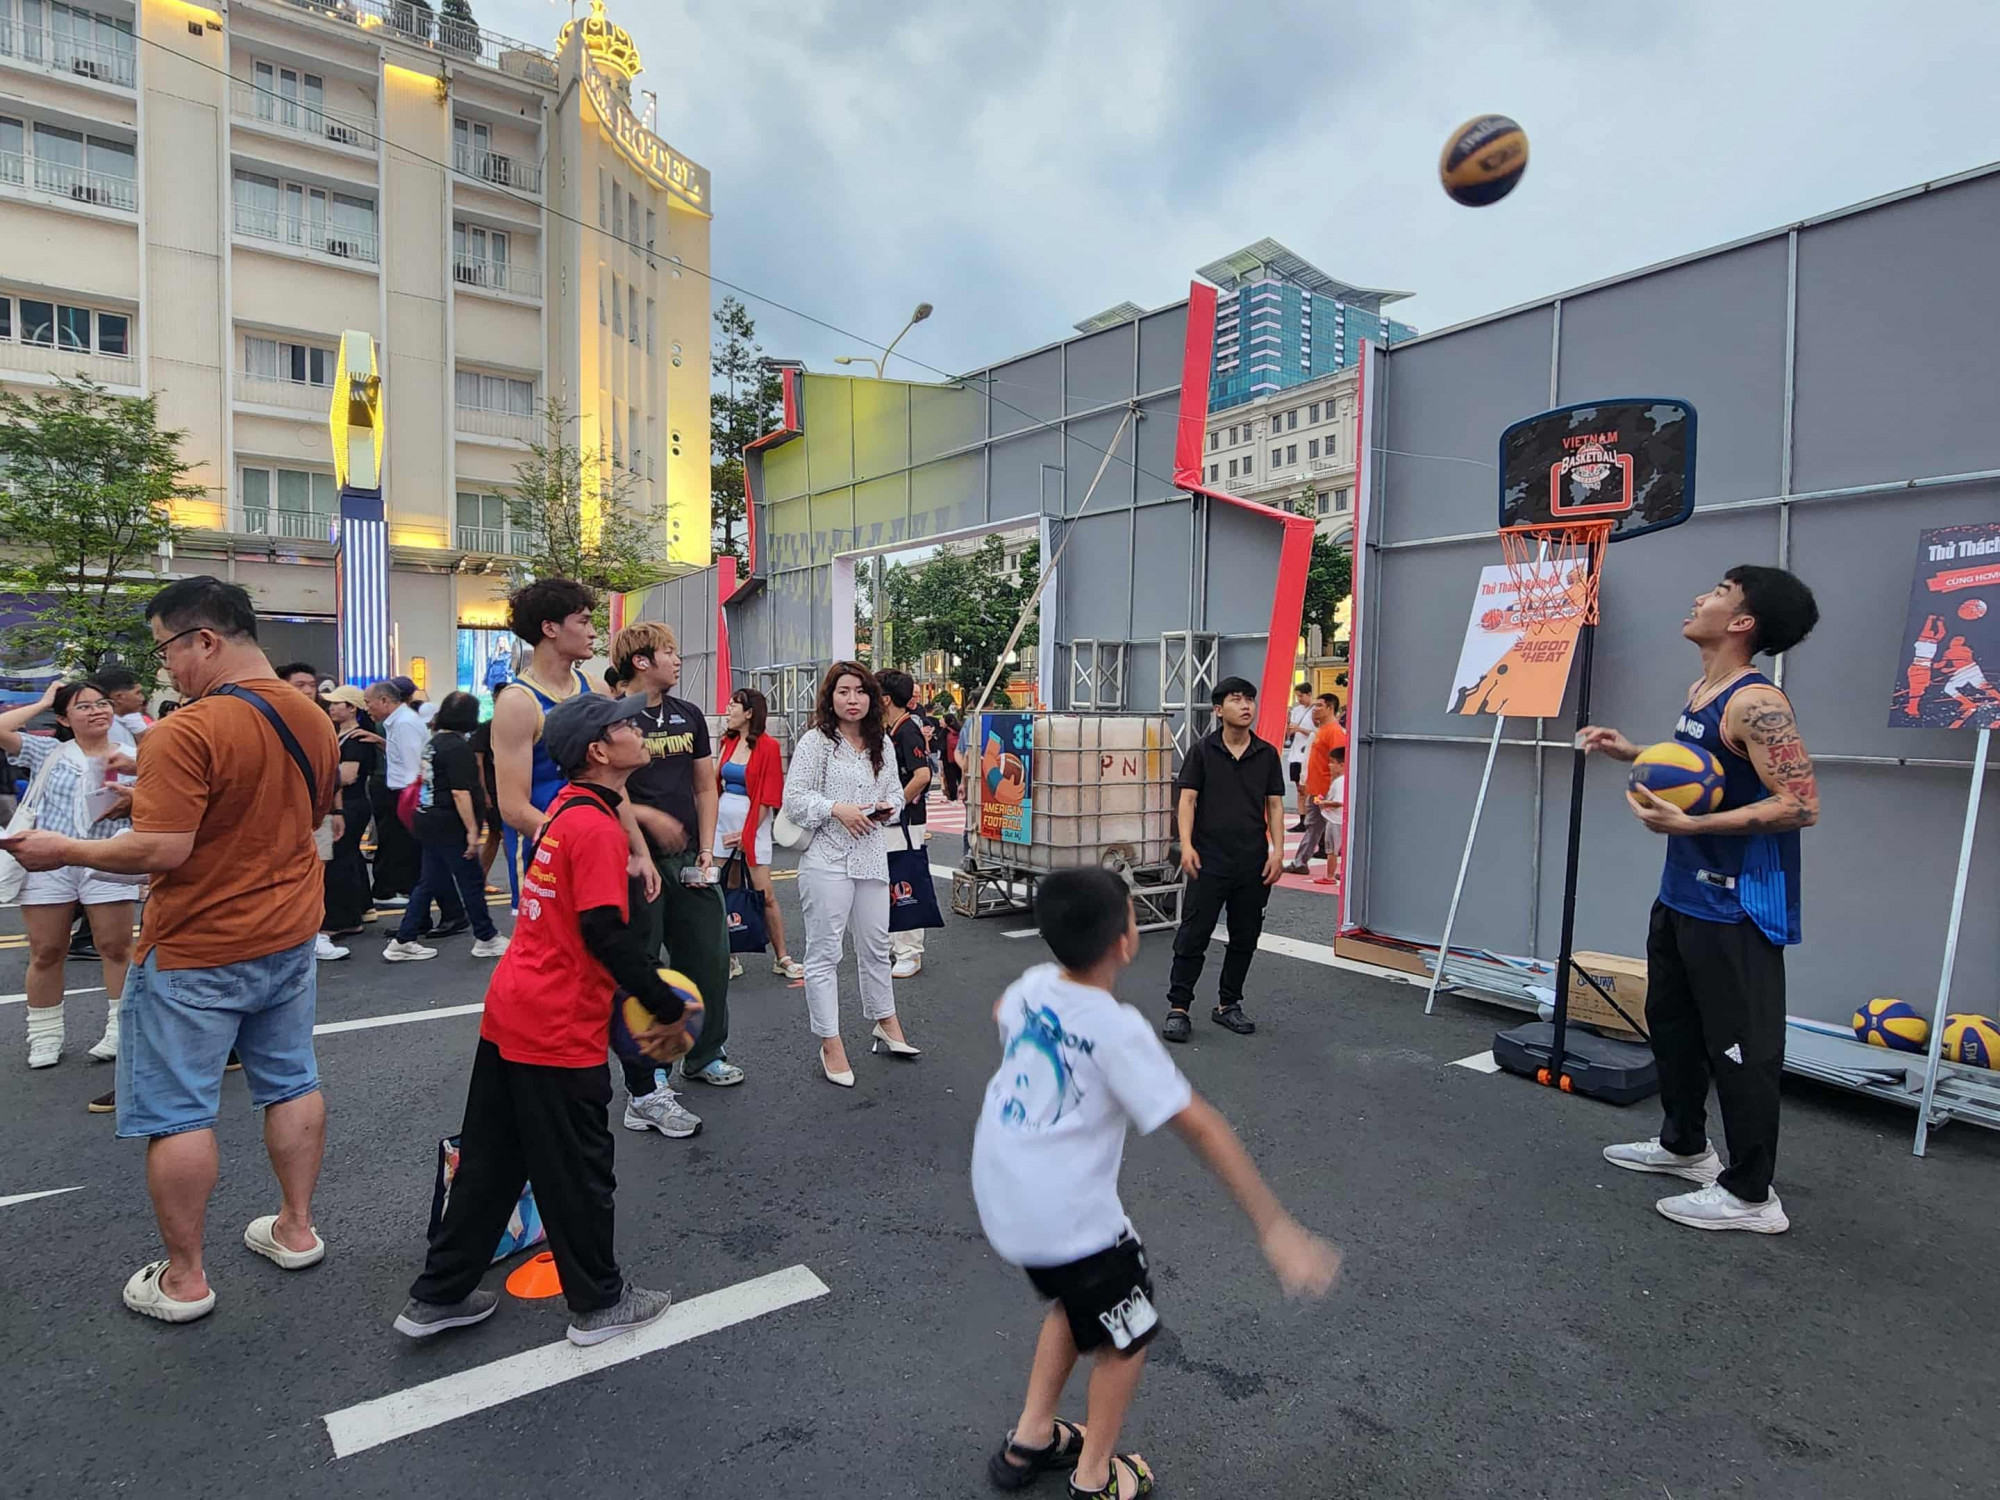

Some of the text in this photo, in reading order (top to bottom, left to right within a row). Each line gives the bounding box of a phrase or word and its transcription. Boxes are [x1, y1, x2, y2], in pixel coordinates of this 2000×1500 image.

[616, 106, 702, 203] HOTEL
[1562, 431, 1618, 449] VIETNAM
[1560, 450, 1623, 475] BASKETBALL
[1512, 640, 1570, 652] SAIGON
[1523, 652, 1566, 663] HEAT
[644, 732, 694, 759] AMPIONS
[983, 802, 1024, 817] AMERICAN
[983, 815, 1022, 830] FOOTBALL
